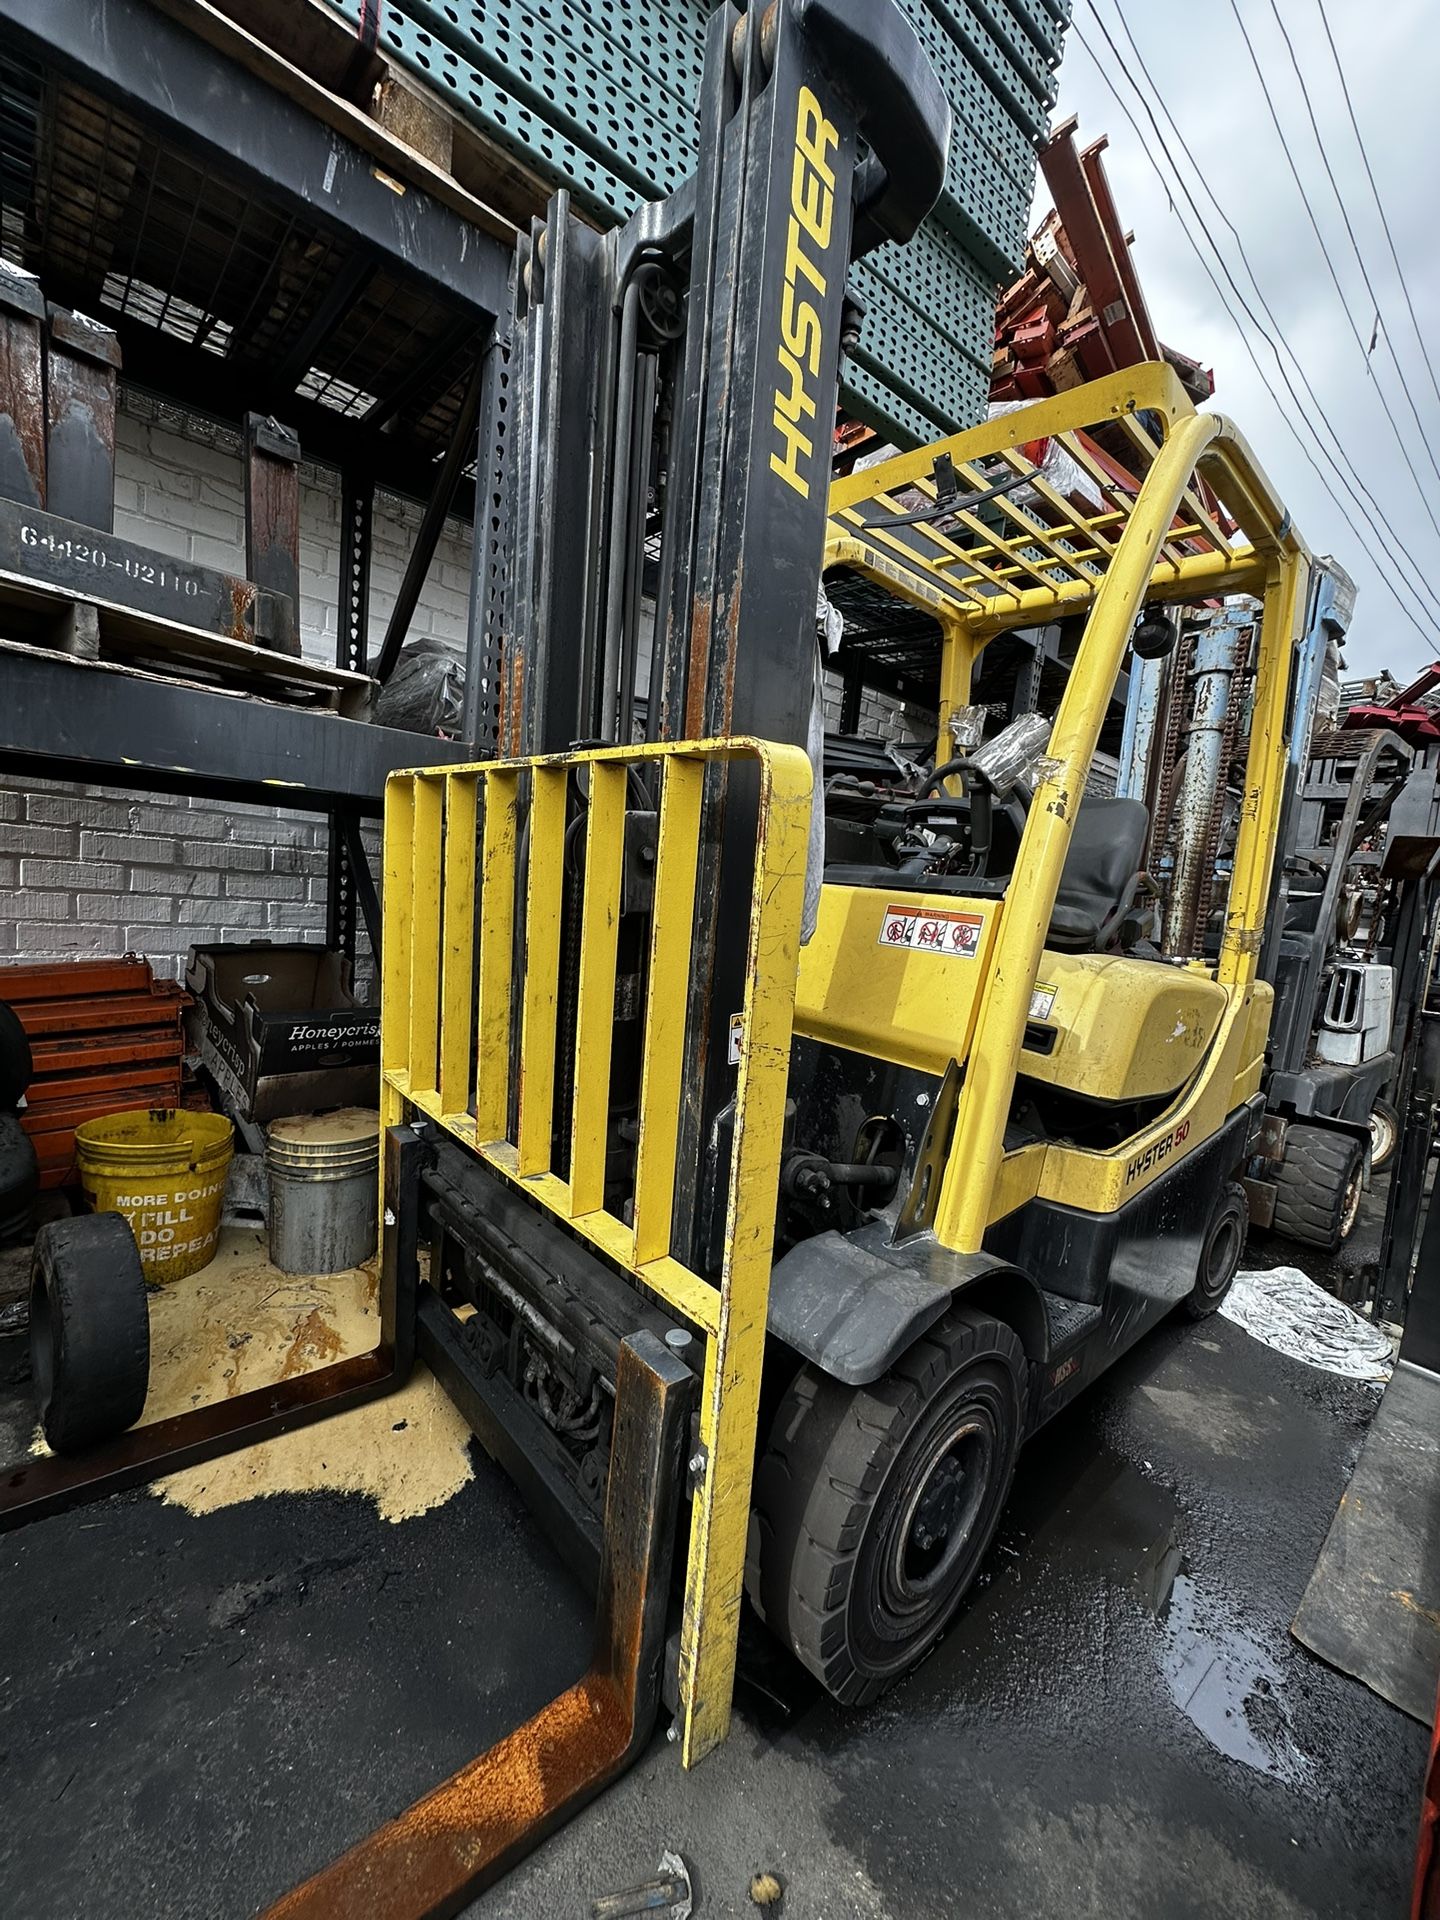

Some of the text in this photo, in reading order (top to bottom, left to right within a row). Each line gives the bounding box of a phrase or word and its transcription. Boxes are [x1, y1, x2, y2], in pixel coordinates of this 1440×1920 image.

[769, 85, 839, 500] HYSTER
[290, 1041, 330, 1052] APPLES
[341, 1038, 380, 1049] POMMES
[210, 1052, 248, 1109] APPLES
[1126, 1120, 1190, 1186] HYSTER 50
[116, 1194, 168, 1207] MORE
[141, 1208, 194, 1228] FILL
[140, 1228, 175, 1246] DO
